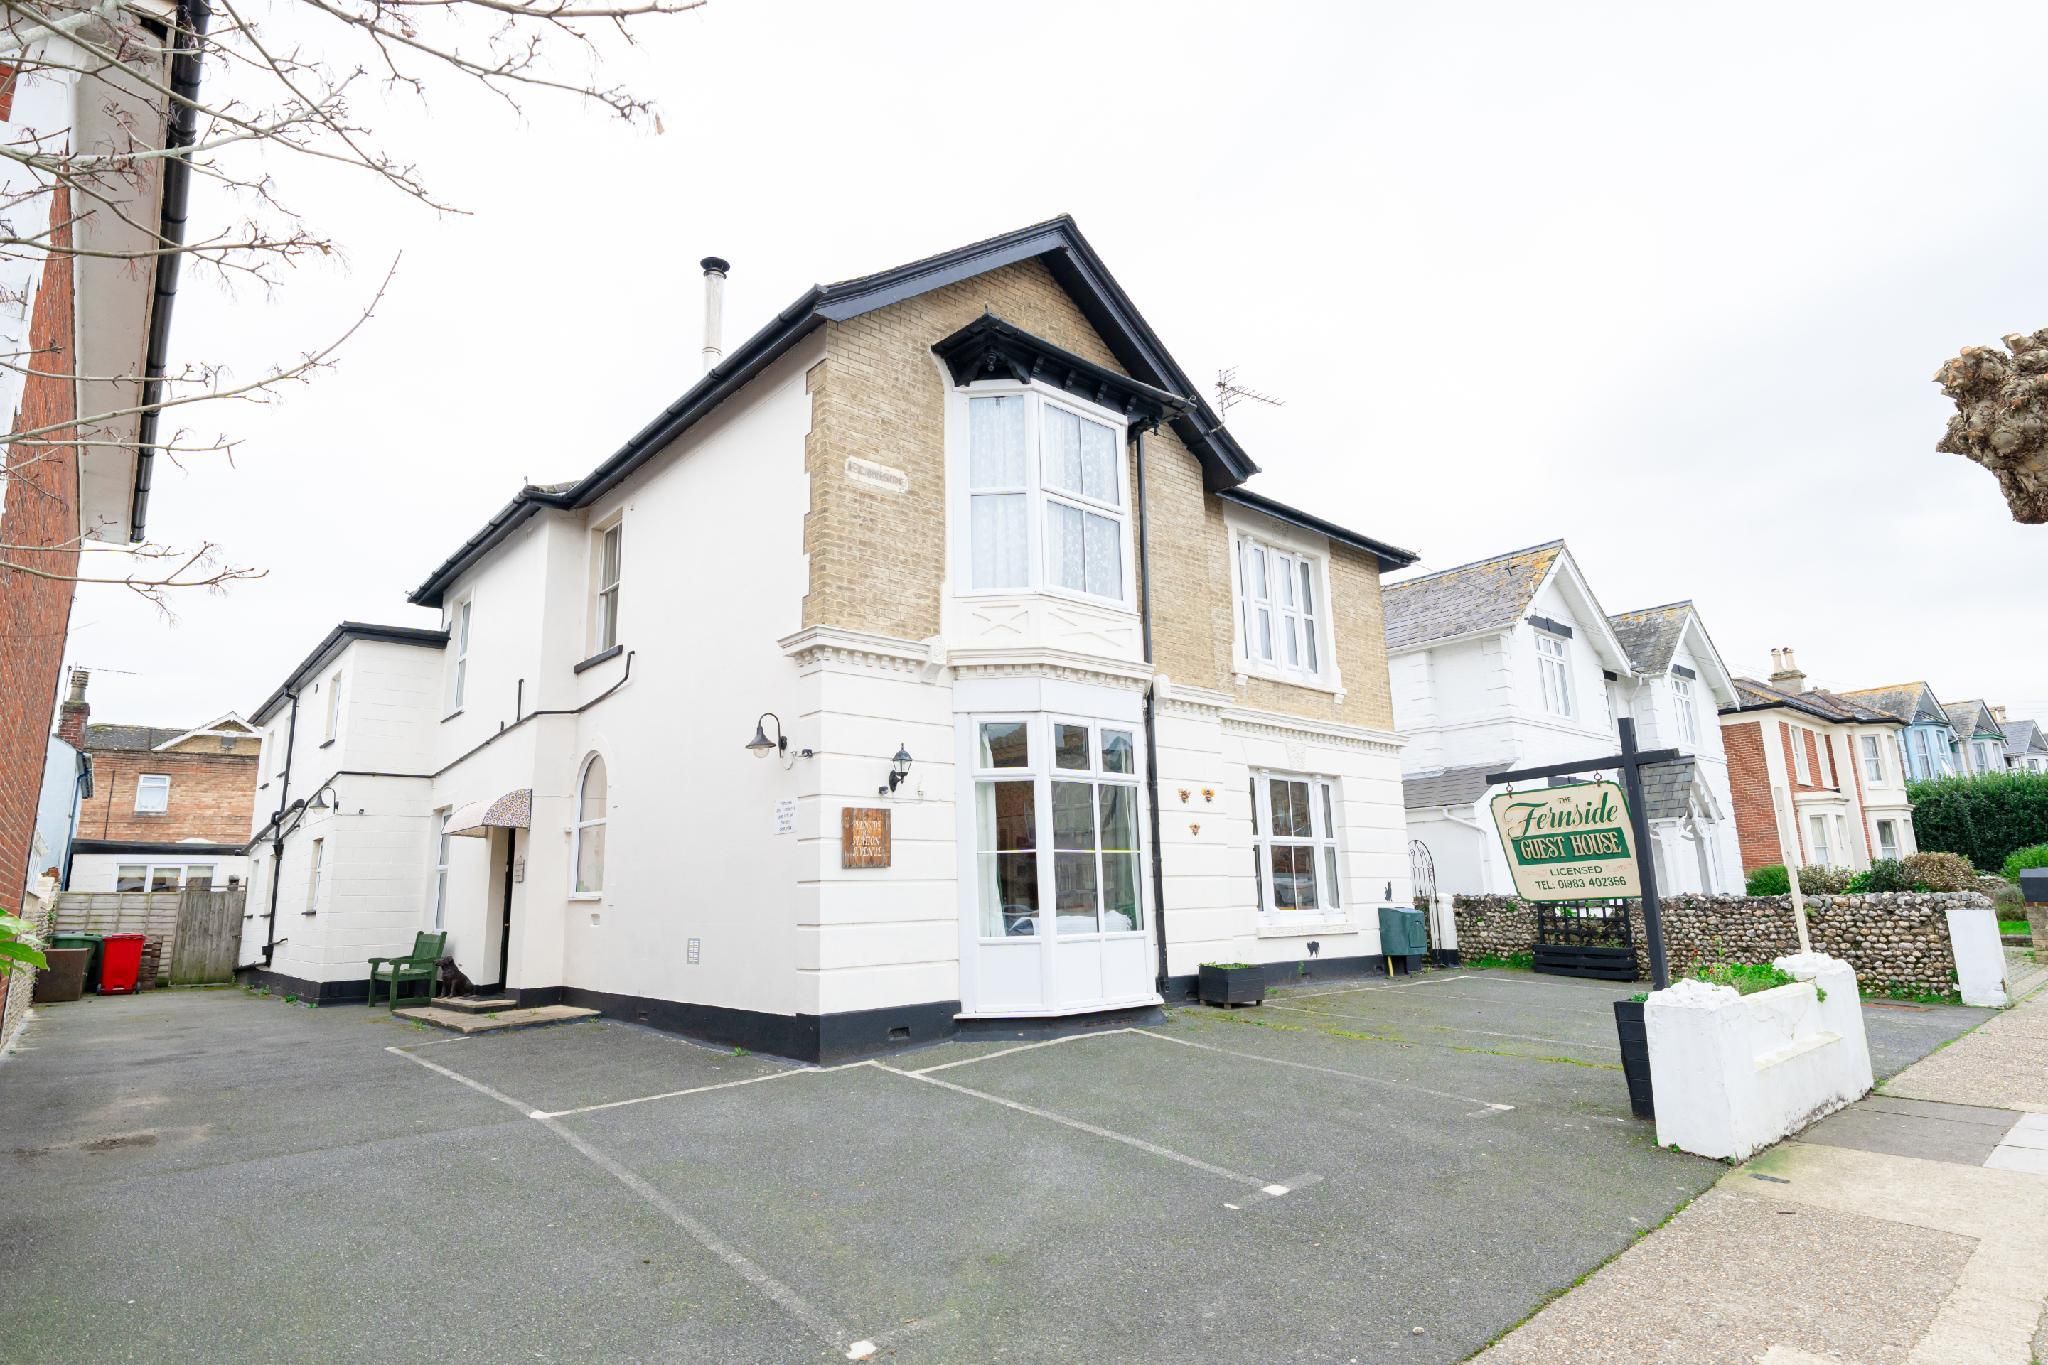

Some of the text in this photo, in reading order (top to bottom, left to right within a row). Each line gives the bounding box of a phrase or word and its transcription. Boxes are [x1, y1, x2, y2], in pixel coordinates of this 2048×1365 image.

[1558, 796, 1571, 804] THE
[1504, 791, 1618, 840] Fernside
[1520, 831, 1622, 860] GUEST HOUSE
[1549, 865, 1603, 876] LICENSED
[1558, 878, 1586, 889] 01983
[1588, 876, 1627, 888] 402356
